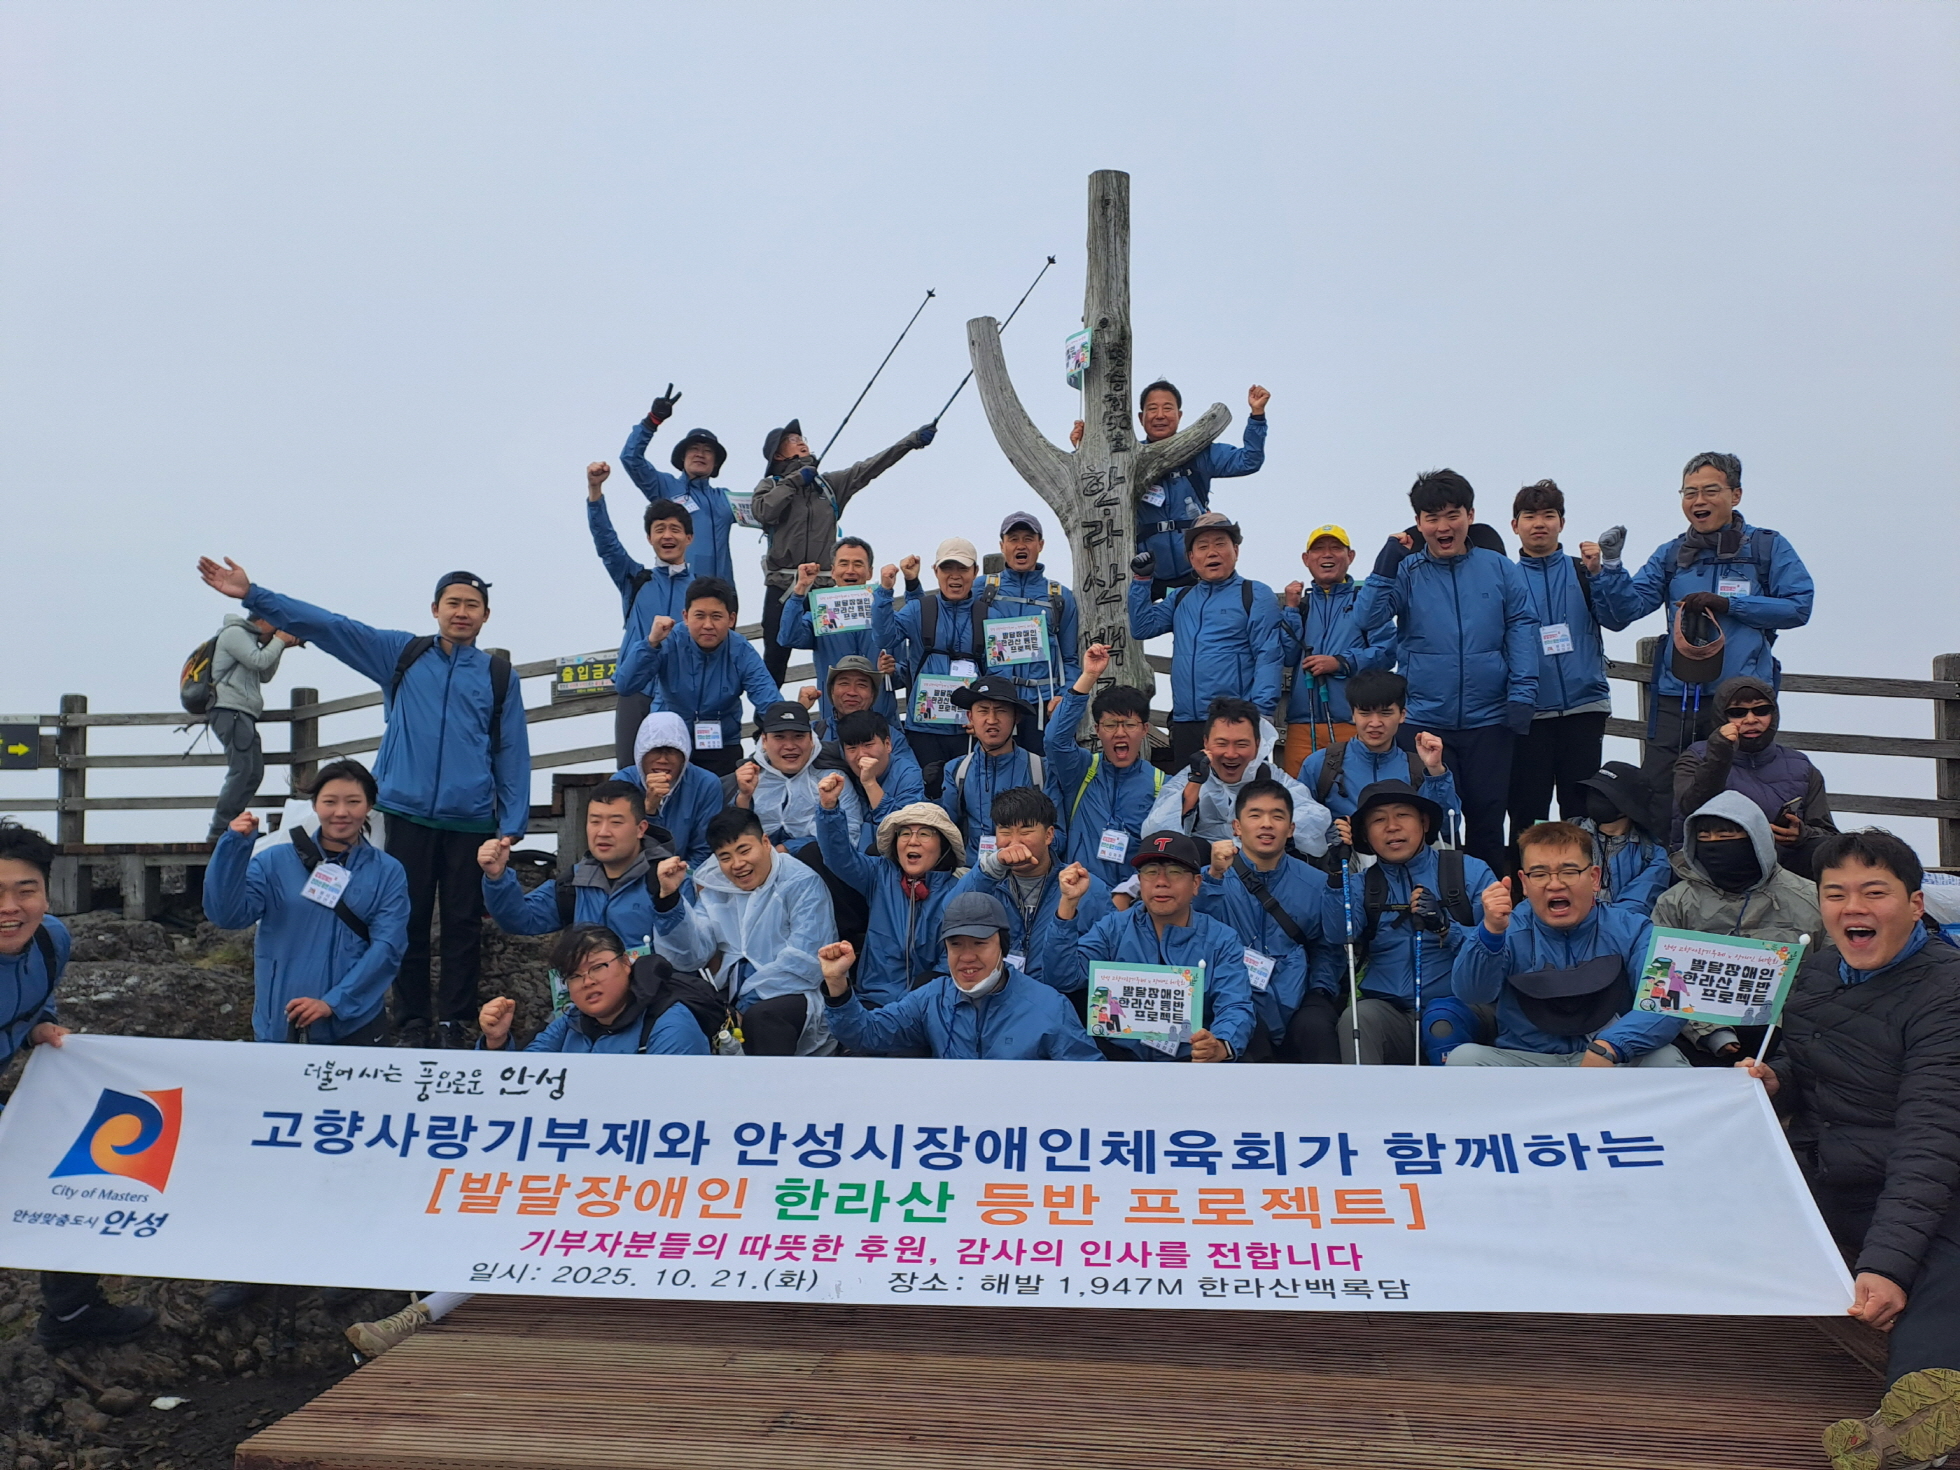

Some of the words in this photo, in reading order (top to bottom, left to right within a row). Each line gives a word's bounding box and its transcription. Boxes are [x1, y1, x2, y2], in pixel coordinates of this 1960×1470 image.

[1153, 837, 1173, 851] T
[1690, 958, 1775, 980] 발달장애인
[1123, 986, 1184, 1000] 발달장애인
[1683, 971, 1732, 990] 한라산
[1738, 979, 1770, 993] 등반
[1118, 997, 1155, 1010] 한라산
[1160, 1000, 1184, 1012] 등반
[1701, 988, 1768, 1006] 프로젝트
[1135, 1010, 1183, 1024] 프로젝트
[304, 1061, 353, 1091] 더불어
[359, 1064, 402, 1082] 사는
[415, 1061, 484, 1102] 풍요로운
[500, 1066, 567, 1100] 안성
[251, 1109, 710, 1167] 고향사랑기부제와
[734, 1120, 1358, 1178] 안성시장애인체육회가
[1384, 1131, 1664, 1175] 함께하는
[52, 1185, 78, 1199] City
[81, 1188, 97, 1198] of
[98, 1189, 149, 1202] Masters
[425, 1167, 748, 1219] [발달장애인
[775, 1178, 955, 1223] 한라산
[977, 1183, 1100, 1225] 등반
[1125, 1183, 1426, 1230] 프로젝트]
[13, 1209, 99, 1228] 안성맞춤도시
[100, 1211, 169, 1237] 안성
[520, 1229, 728, 1260] 기부자분들의
[739, 1234, 844, 1262] 따뜻한
[855, 1235, 936, 1265] 후원,
[957, 1238, 1063, 1266] 감사의
[1080, 1241, 1190, 1268] 인사를
[1207, 1242, 1363, 1271] 전합니다
[470, 1263, 541, 1283] 일시:
[552, 1266, 635, 1286] 2025.
[658, 1269, 695, 1287] 10.
[888, 1272, 963, 1293] 장소:
[981, 1274, 1044, 1294] 해발
[1060, 1277, 1182, 1297] 1,947M
[1198, 1277, 1410, 1299] 한라산백록담
